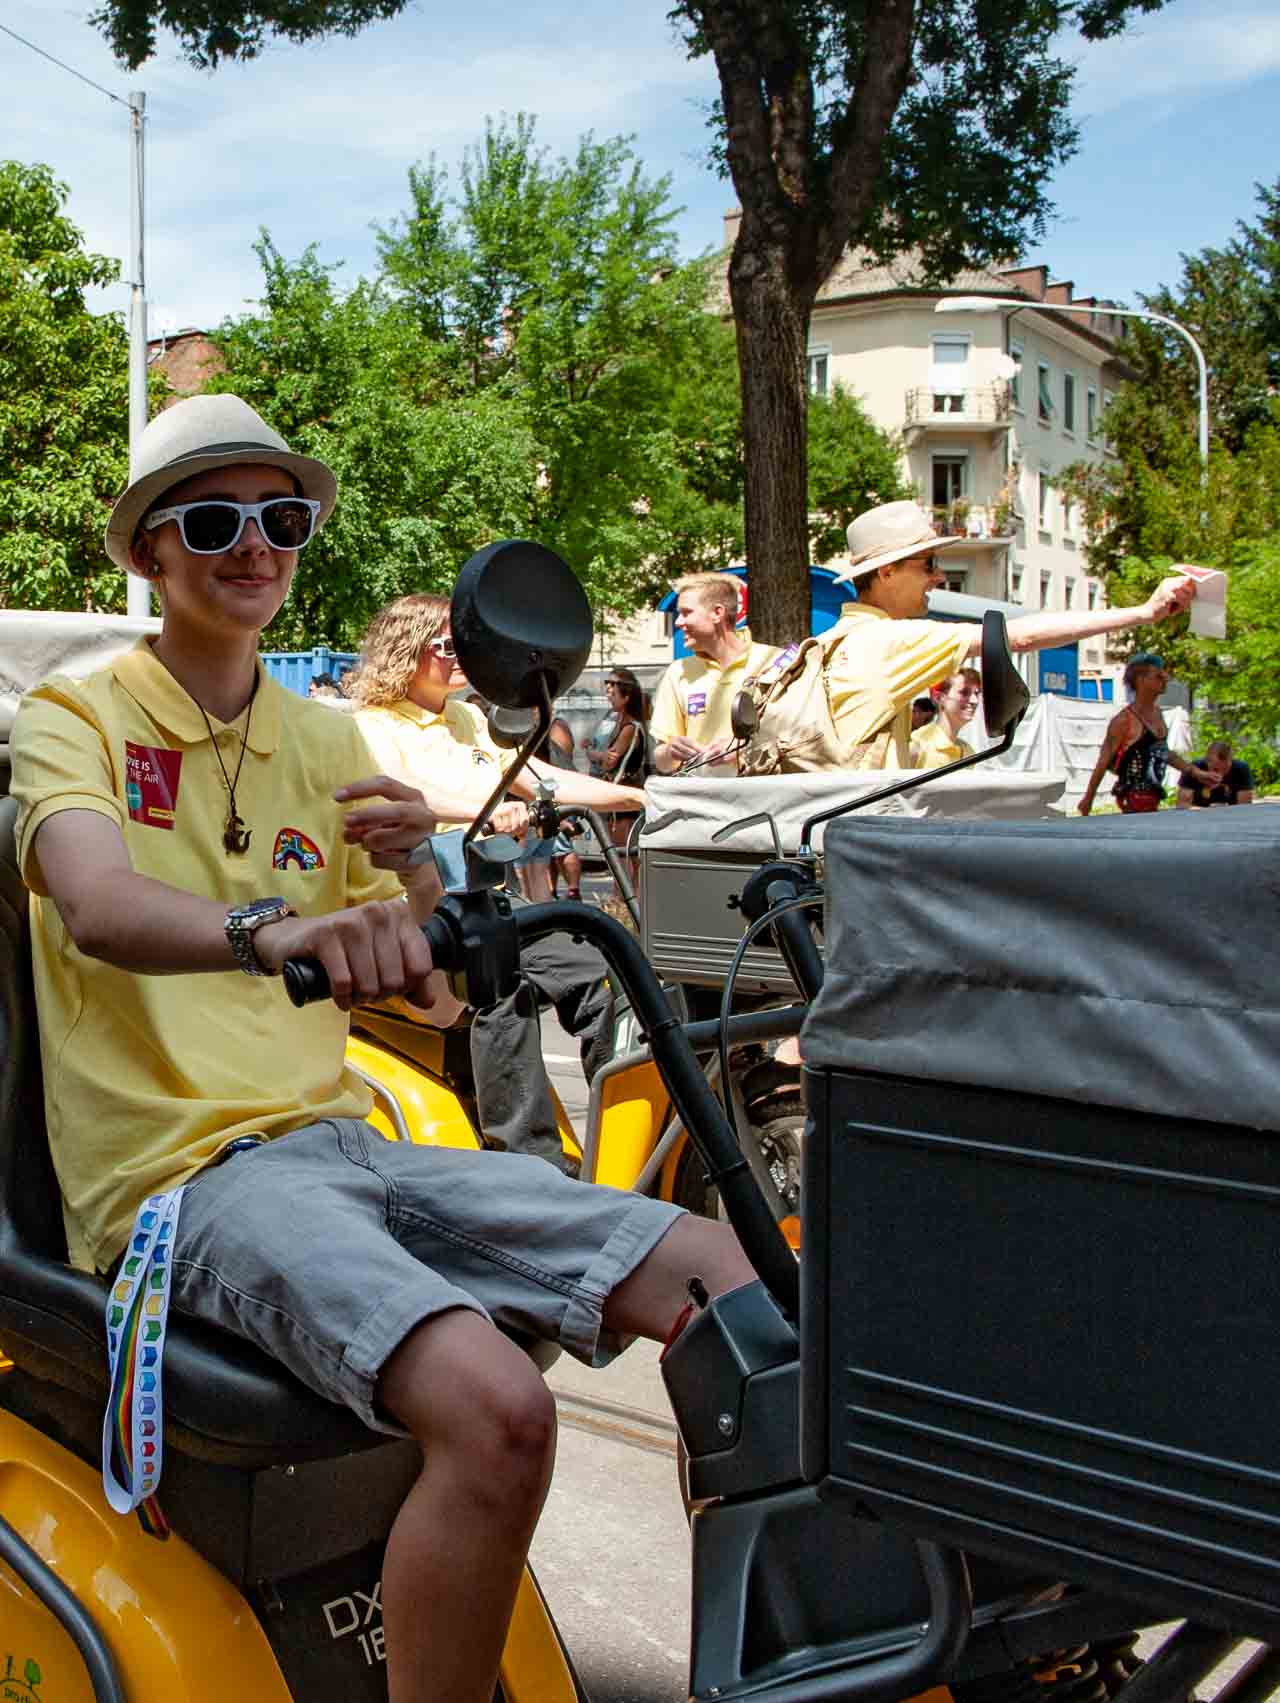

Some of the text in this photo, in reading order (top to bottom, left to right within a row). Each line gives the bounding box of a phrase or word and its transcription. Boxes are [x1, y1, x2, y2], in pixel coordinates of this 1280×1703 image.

[127, 757, 151, 771] OVE IS
[130, 767, 159, 785] THE AIR
